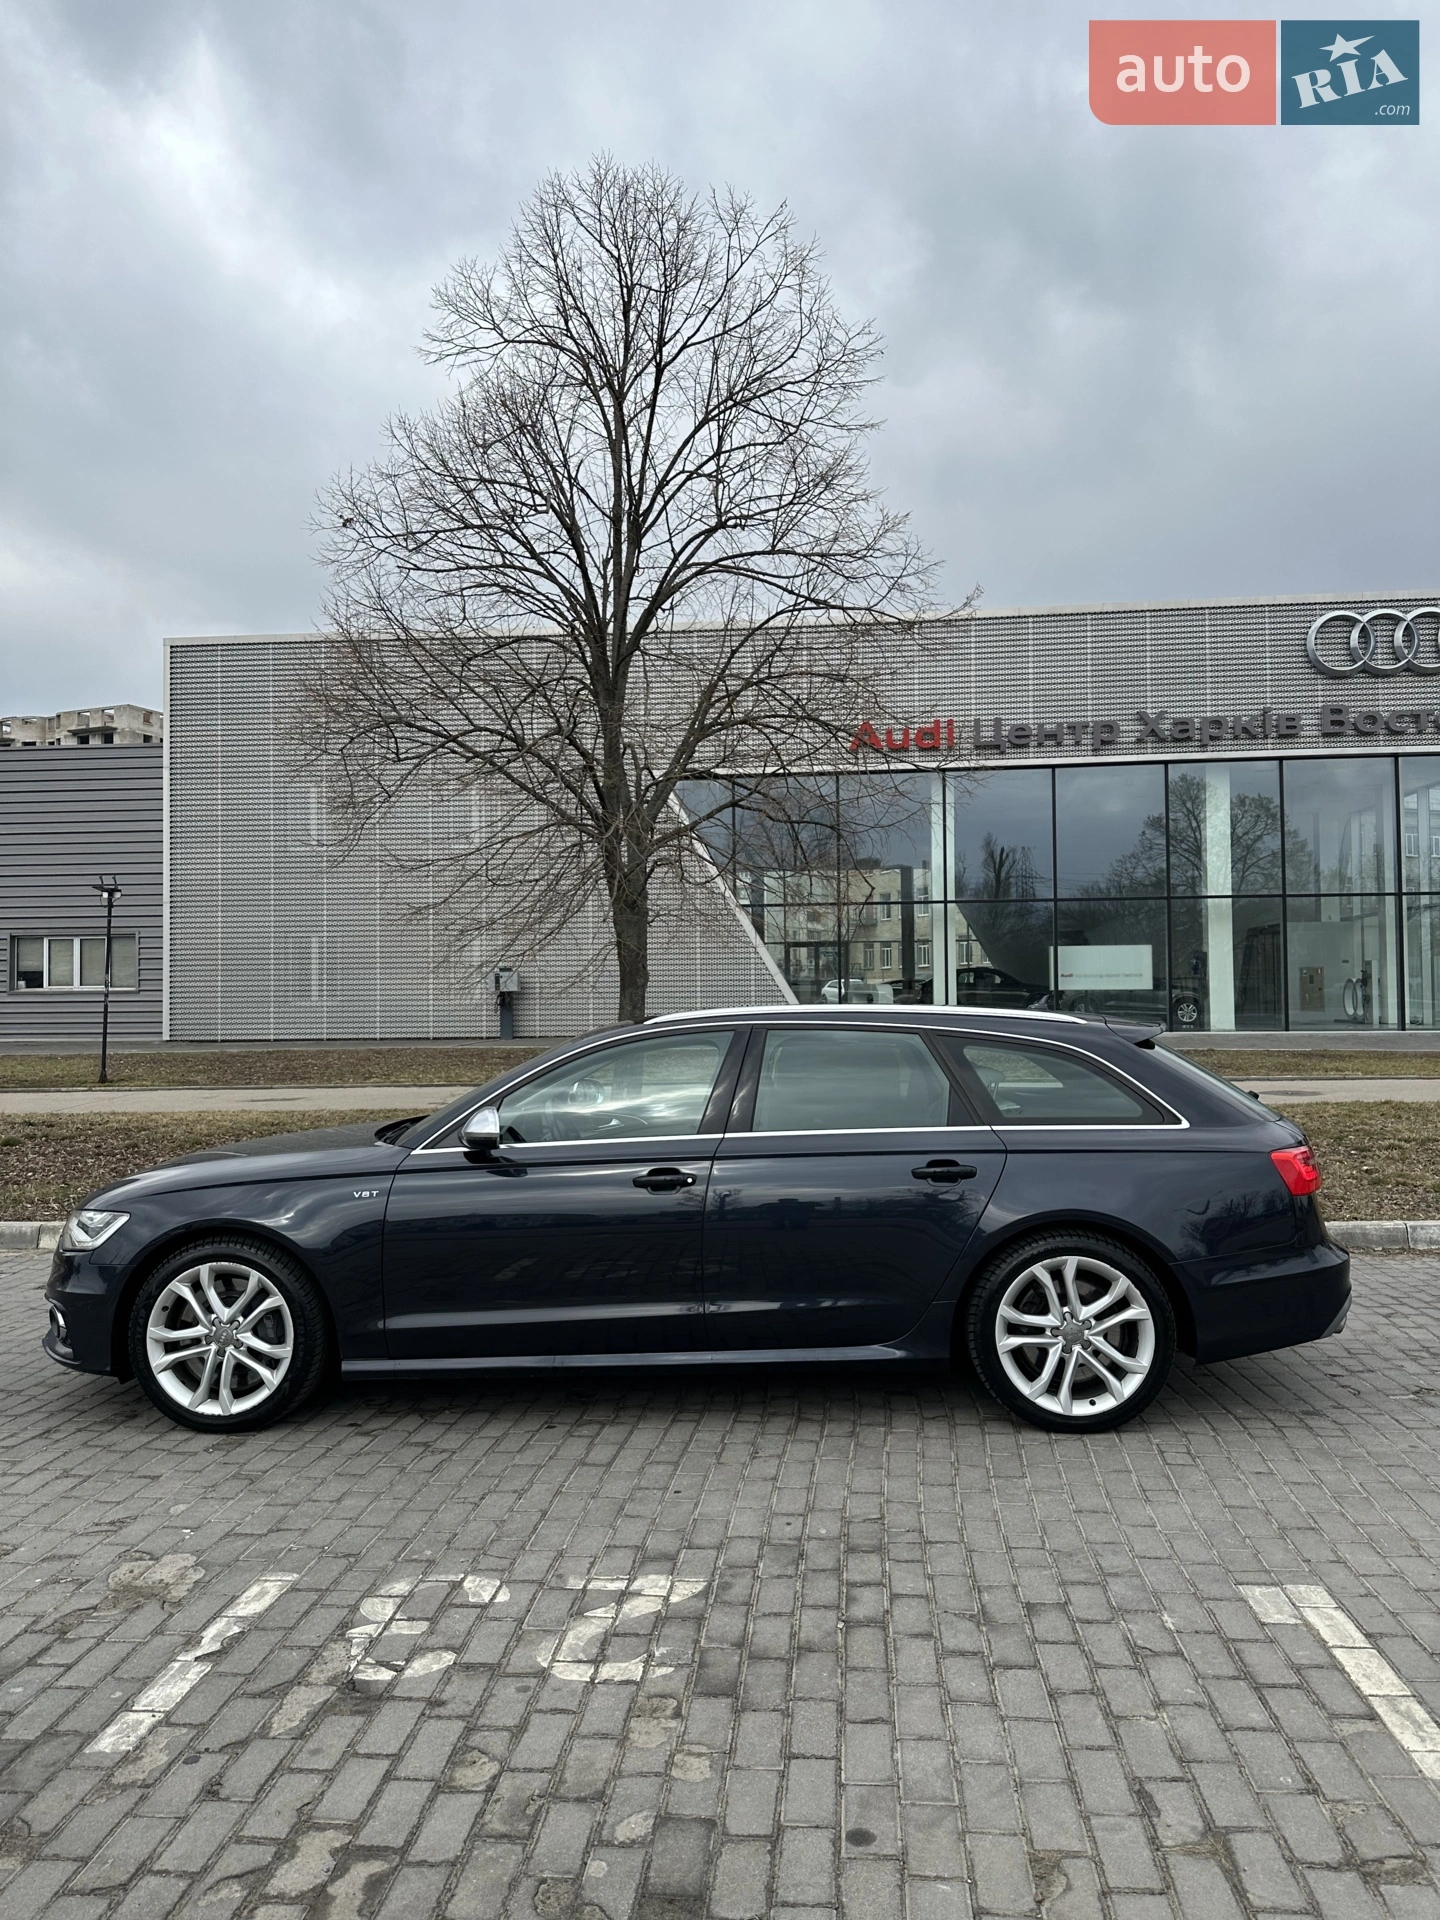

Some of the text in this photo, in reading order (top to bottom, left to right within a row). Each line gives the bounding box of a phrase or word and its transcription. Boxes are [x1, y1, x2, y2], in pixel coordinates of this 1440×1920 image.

[849, 703, 1440, 753] Audi Центр Харків Вост
[353, 1190, 379, 1198] V8T
